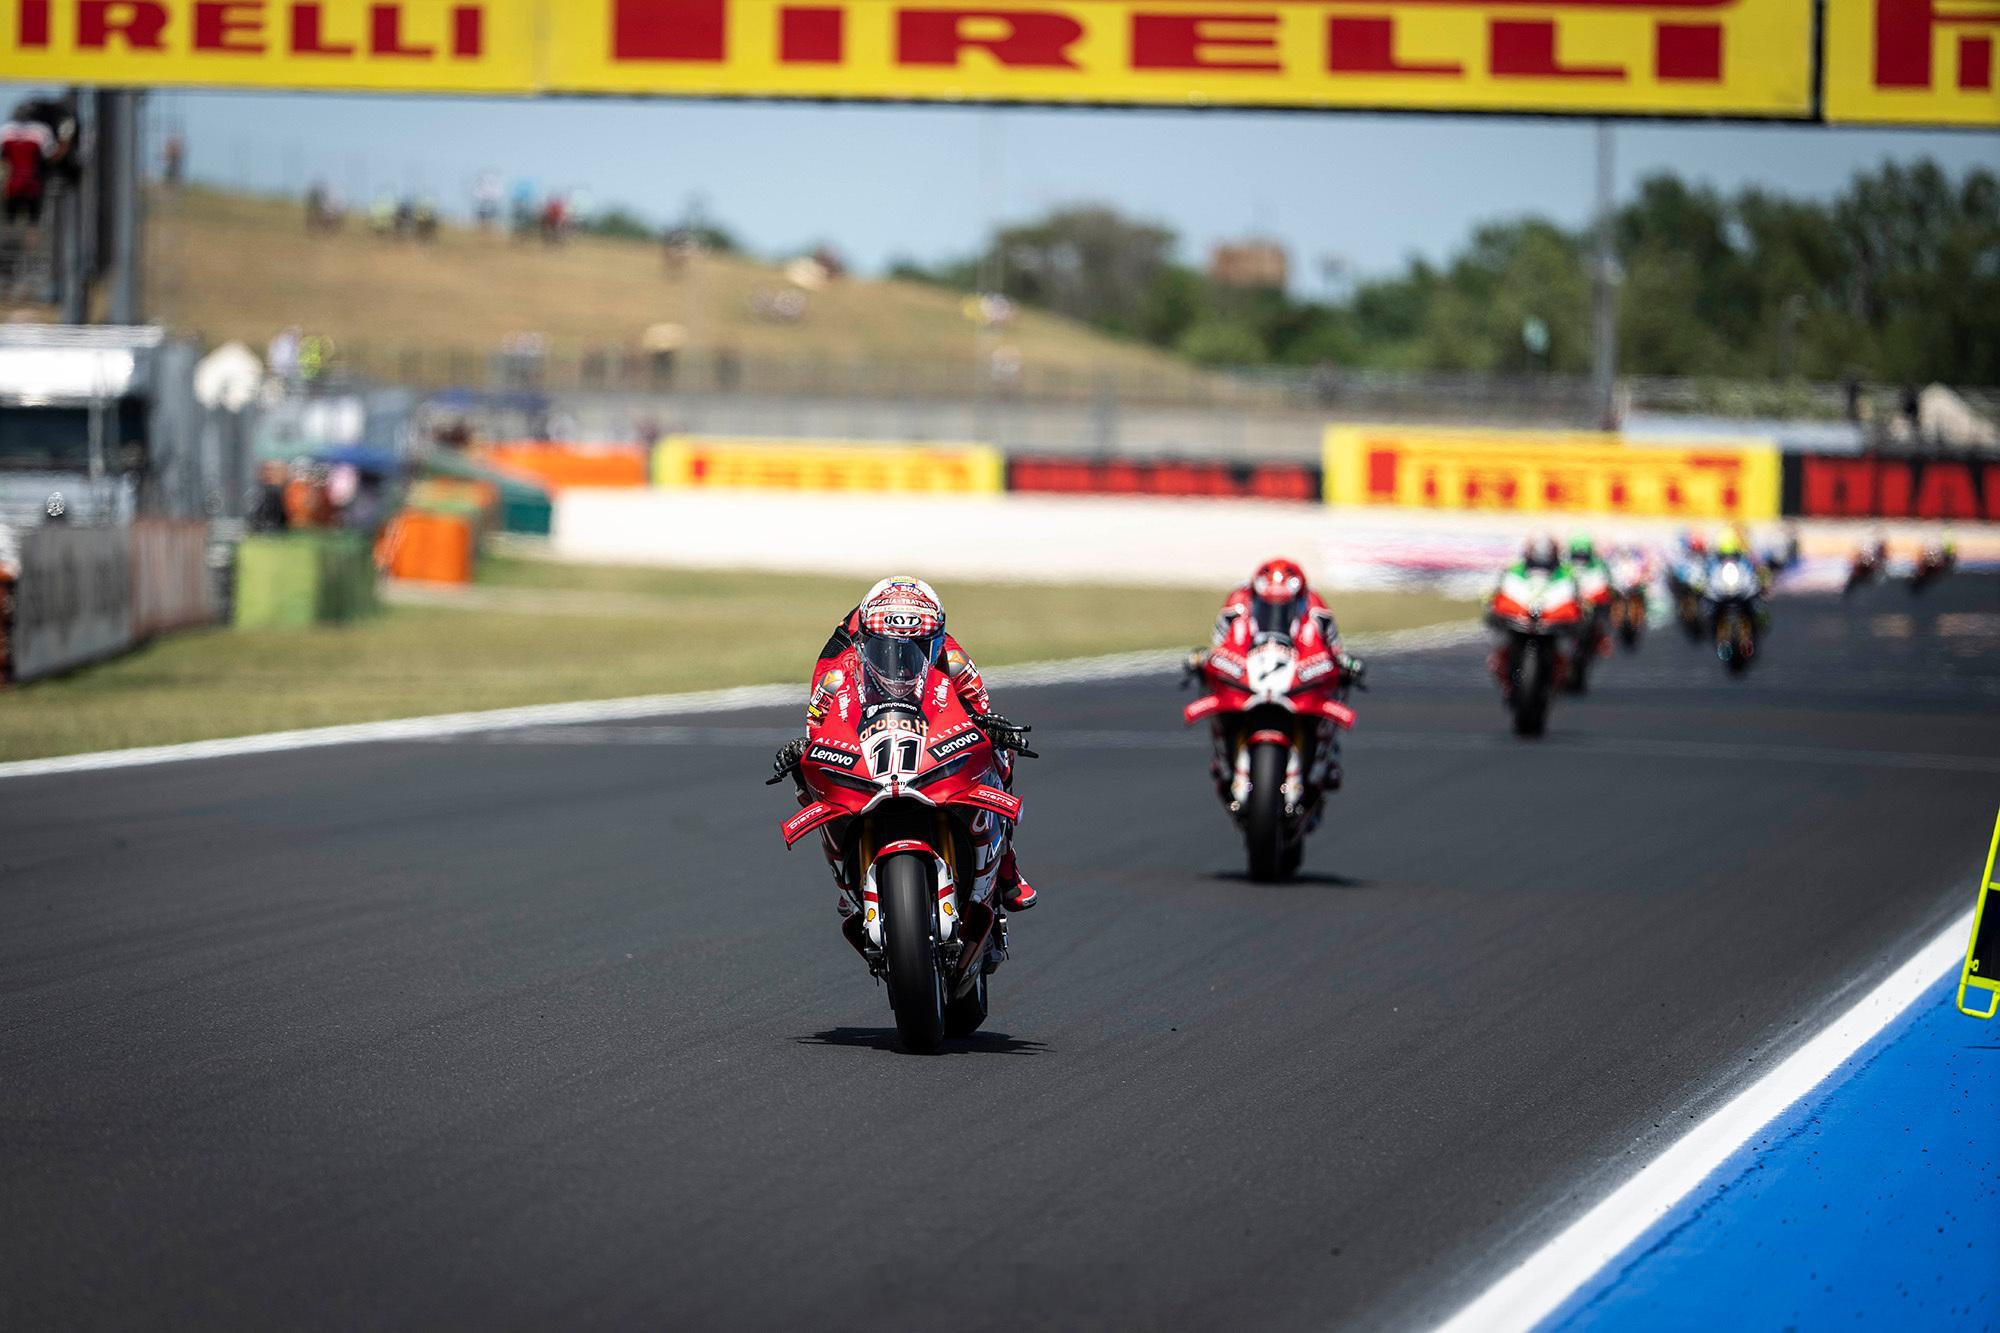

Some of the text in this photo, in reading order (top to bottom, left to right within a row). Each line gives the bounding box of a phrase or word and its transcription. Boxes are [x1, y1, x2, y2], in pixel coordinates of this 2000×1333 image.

[14, 0, 486, 60] IRELLI
[884, 615, 922, 625] KYT
[859, 712, 929, 742] aruba.it
[929, 720, 973, 744] ALTEN
[810, 746, 853, 766] Lenovo
[815, 737, 860, 752] ALTEN
[932, 732, 979, 758] Lenovo
[871, 736, 920, 778] 11
[978, 790, 1014, 807] Dierre
